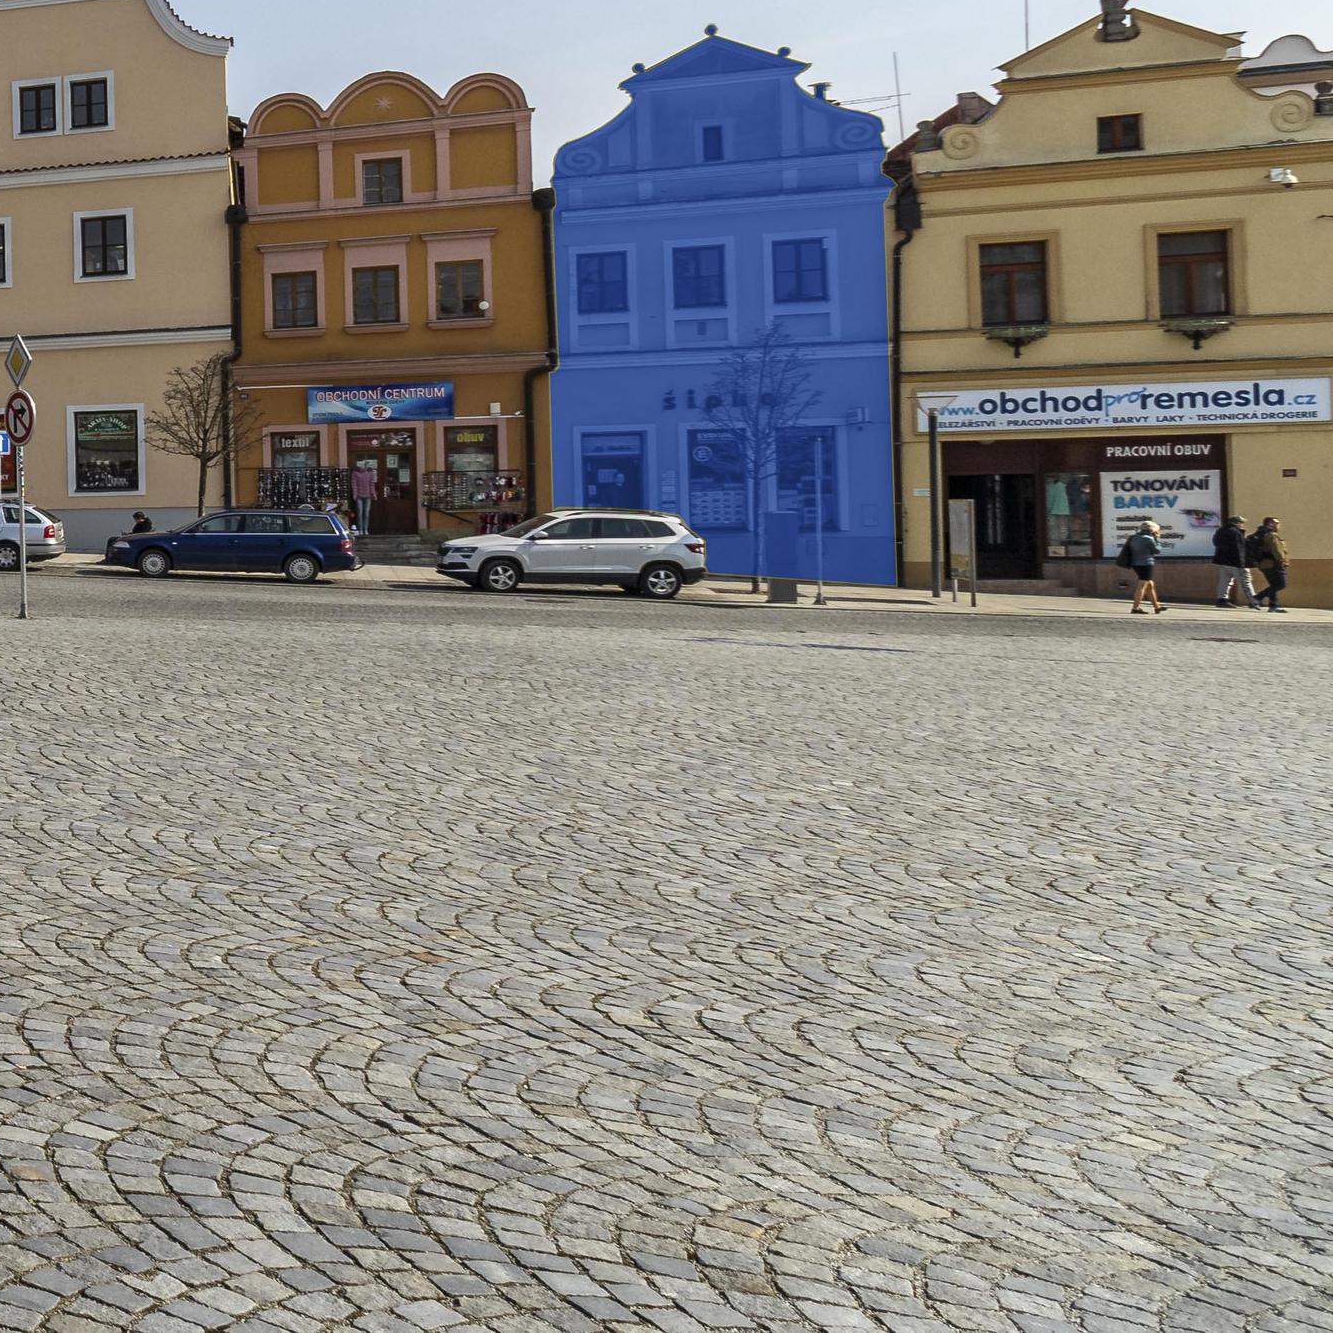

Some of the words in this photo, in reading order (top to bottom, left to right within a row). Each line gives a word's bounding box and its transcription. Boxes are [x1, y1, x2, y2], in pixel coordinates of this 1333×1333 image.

[317, 387, 381, 402] OBCHODNÍ
[385, 387, 445, 399] CENTRUM
[939, 418, 996, 429] ELEZÁŘSTVÍ
[1007, 416, 1063, 427] PRACOVNÍ
[1064, 415, 1101, 426] ODĚVY
[1112, 415, 1149, 424] BARVY
[1156, 414, 1184, 423] LAKY
[1196, 410, 1259, 422] TECHNICKÁ
[1261, 410, 1318, 420] DROGERIE
[1106, 443, 1171, 457] PRACOVNÍ
[1174, 444, 1211, 456] OBUV
[1110, 475, 1210, 492] TÓNOVÁNÍ
[1114, 495, 1178, 509] BAREV
